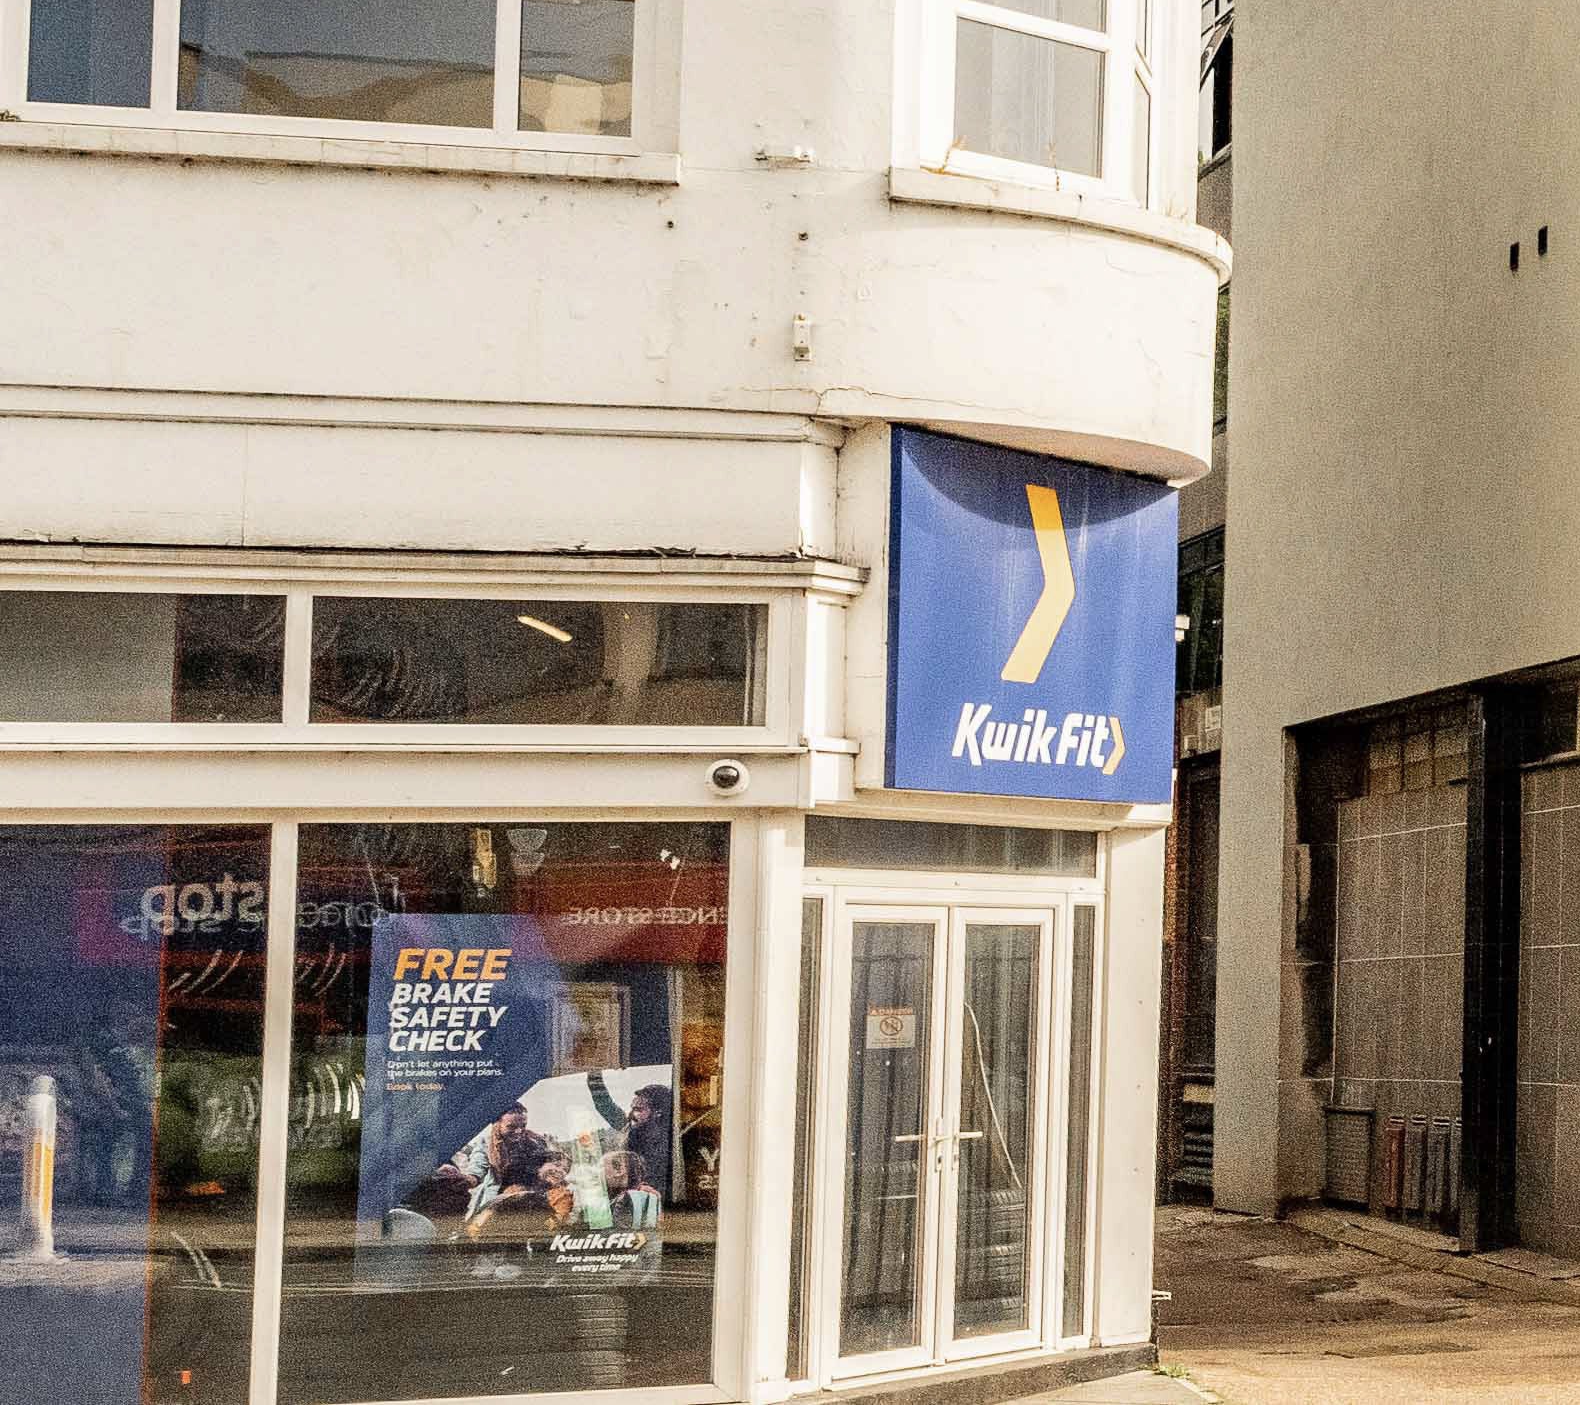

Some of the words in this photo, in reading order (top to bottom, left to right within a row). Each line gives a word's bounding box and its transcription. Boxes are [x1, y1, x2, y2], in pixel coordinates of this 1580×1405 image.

[392, 947, 513, 981] FREE
[390, 982, 494, 1004] BRAKE
[389, 1006, 509, 1028] SAFETY
[388, 1030, 487, 1052] CHECK
[432, 1059, 474, 1070] anything
[476, 1059, 494, 1070] put
[438, 1069, 452, 1077] on
[453, 1070, 476, 1078] your
